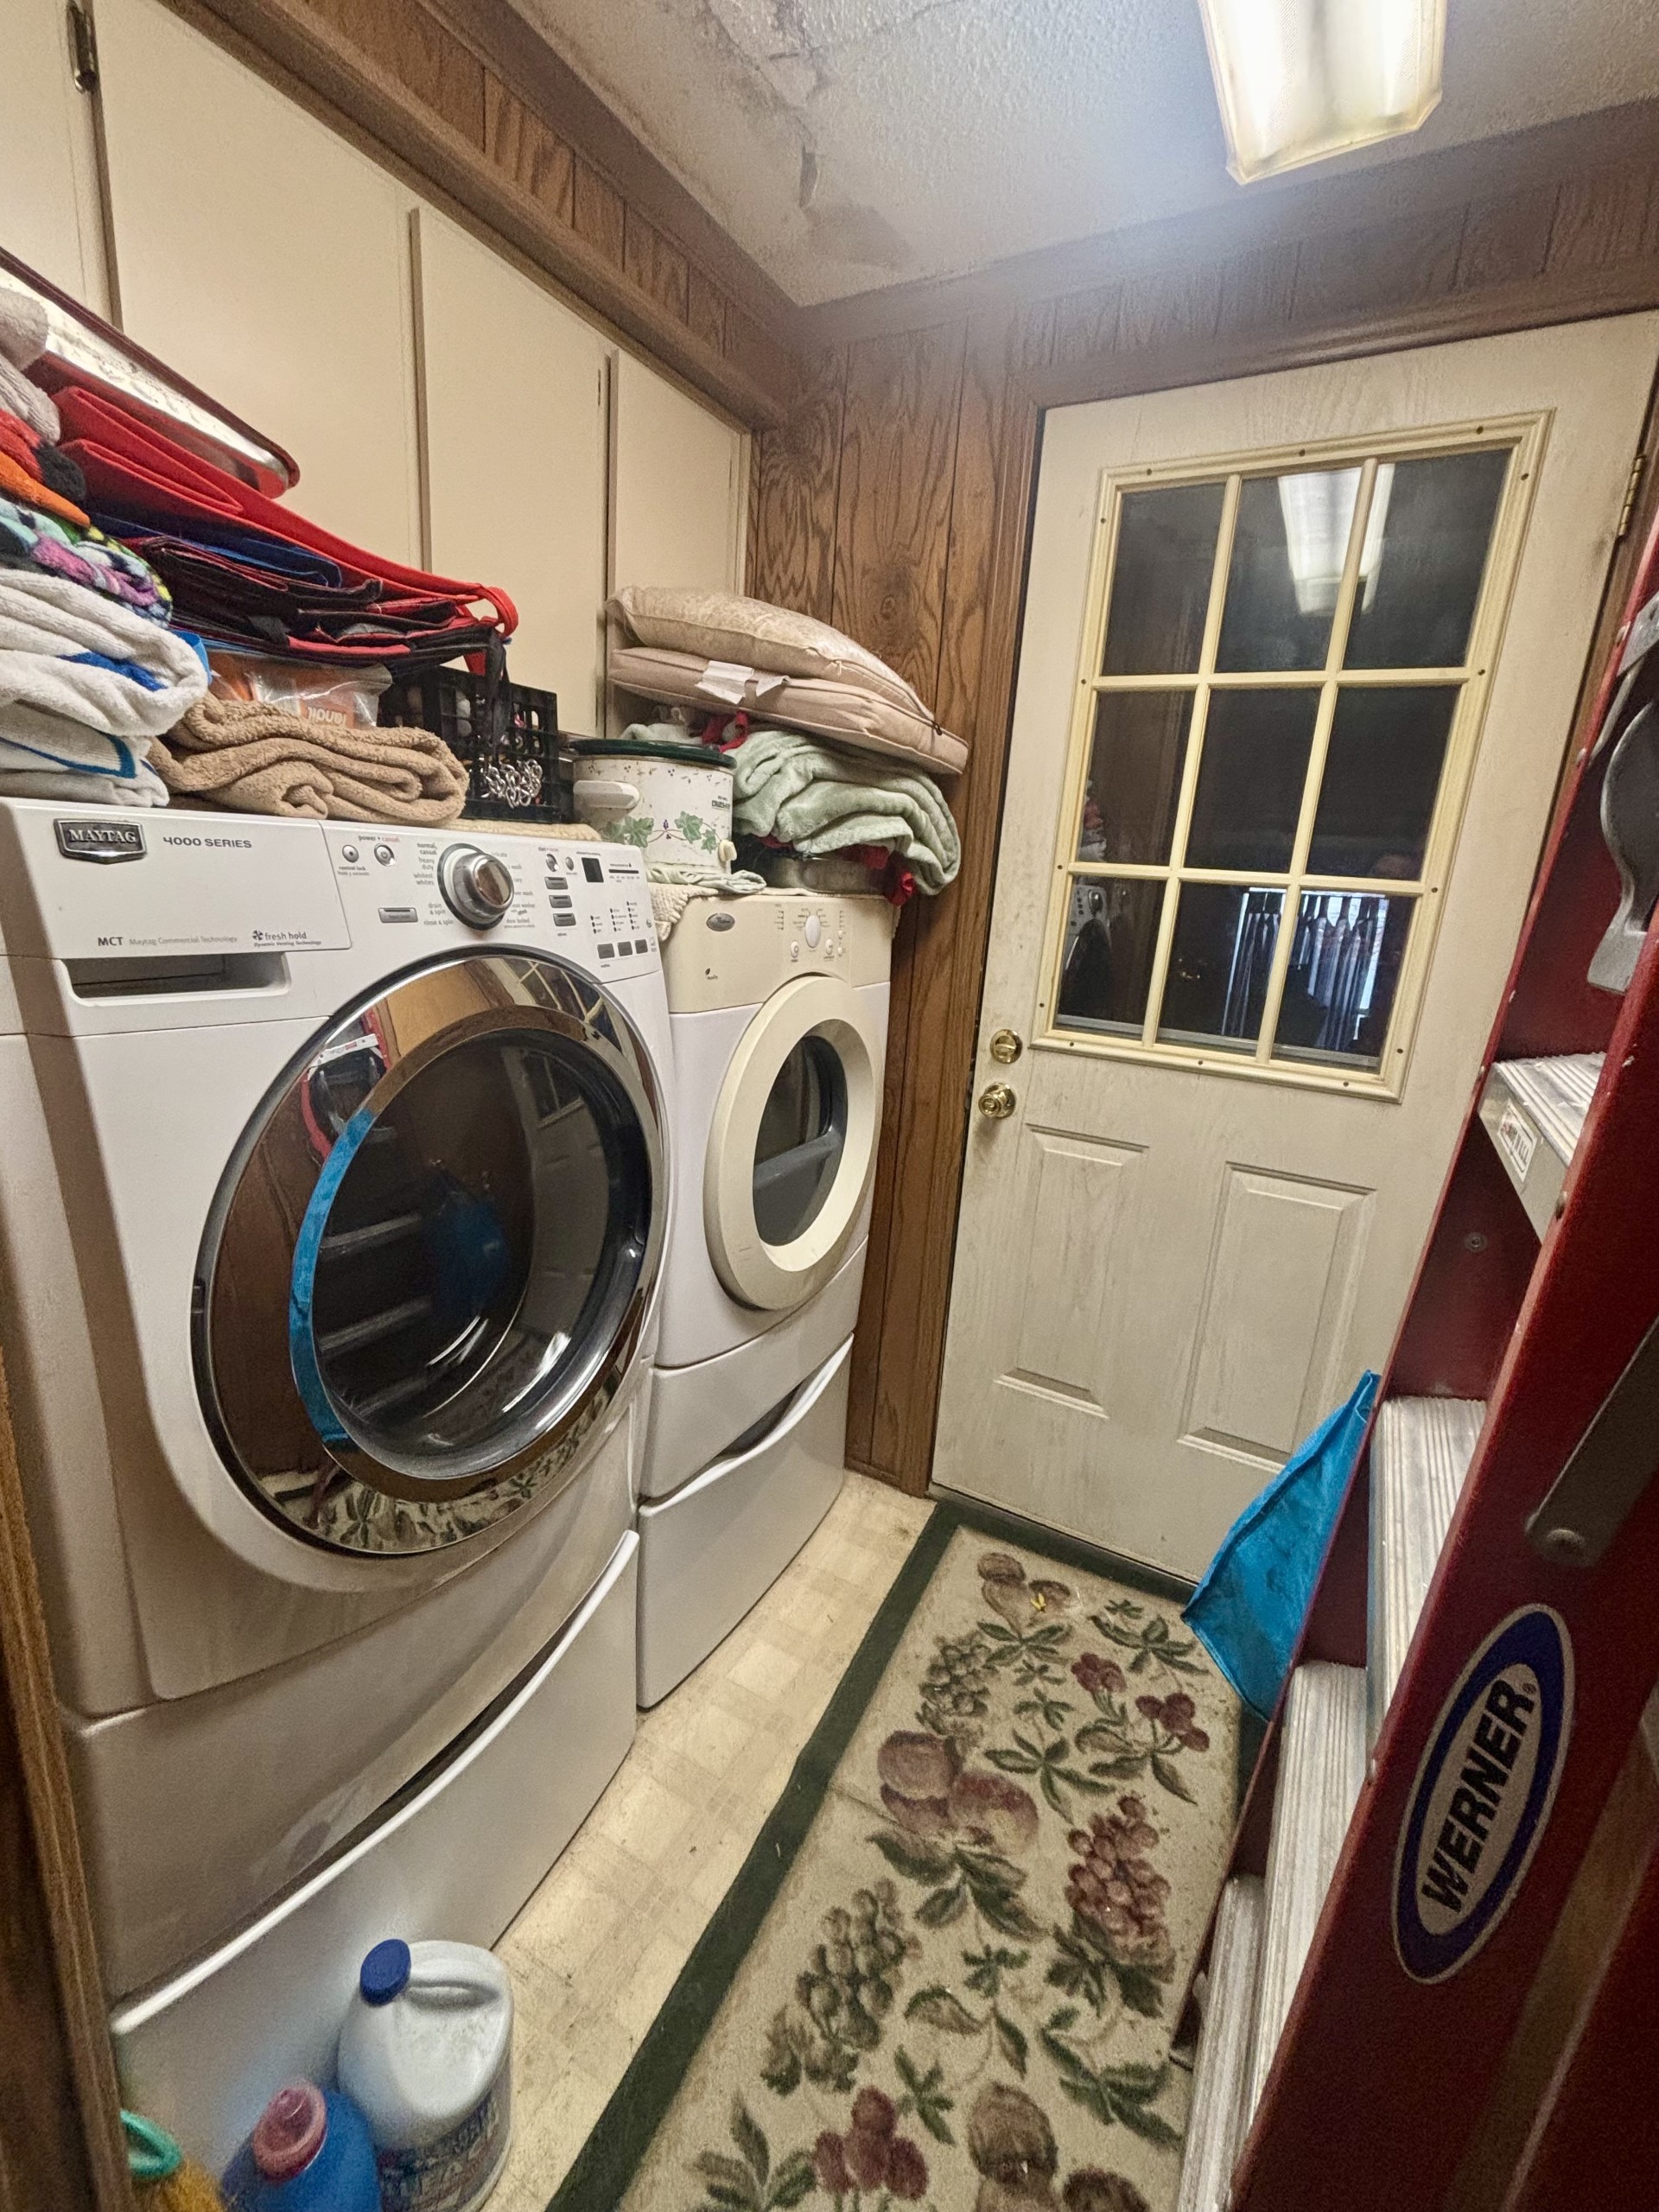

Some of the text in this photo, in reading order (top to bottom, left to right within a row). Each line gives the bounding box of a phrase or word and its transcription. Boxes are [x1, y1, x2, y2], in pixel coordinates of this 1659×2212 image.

[68, 829, 137, 844] MAYTAG
[162, 836, 252, 849] 4000 SERIES
[98, 937, 123, 947] MCT
[200, 935, 238, 944] Technology
[264, 931, 308, 940] fresh hold
[1421, 1679, 1535, 1914] WERNER
